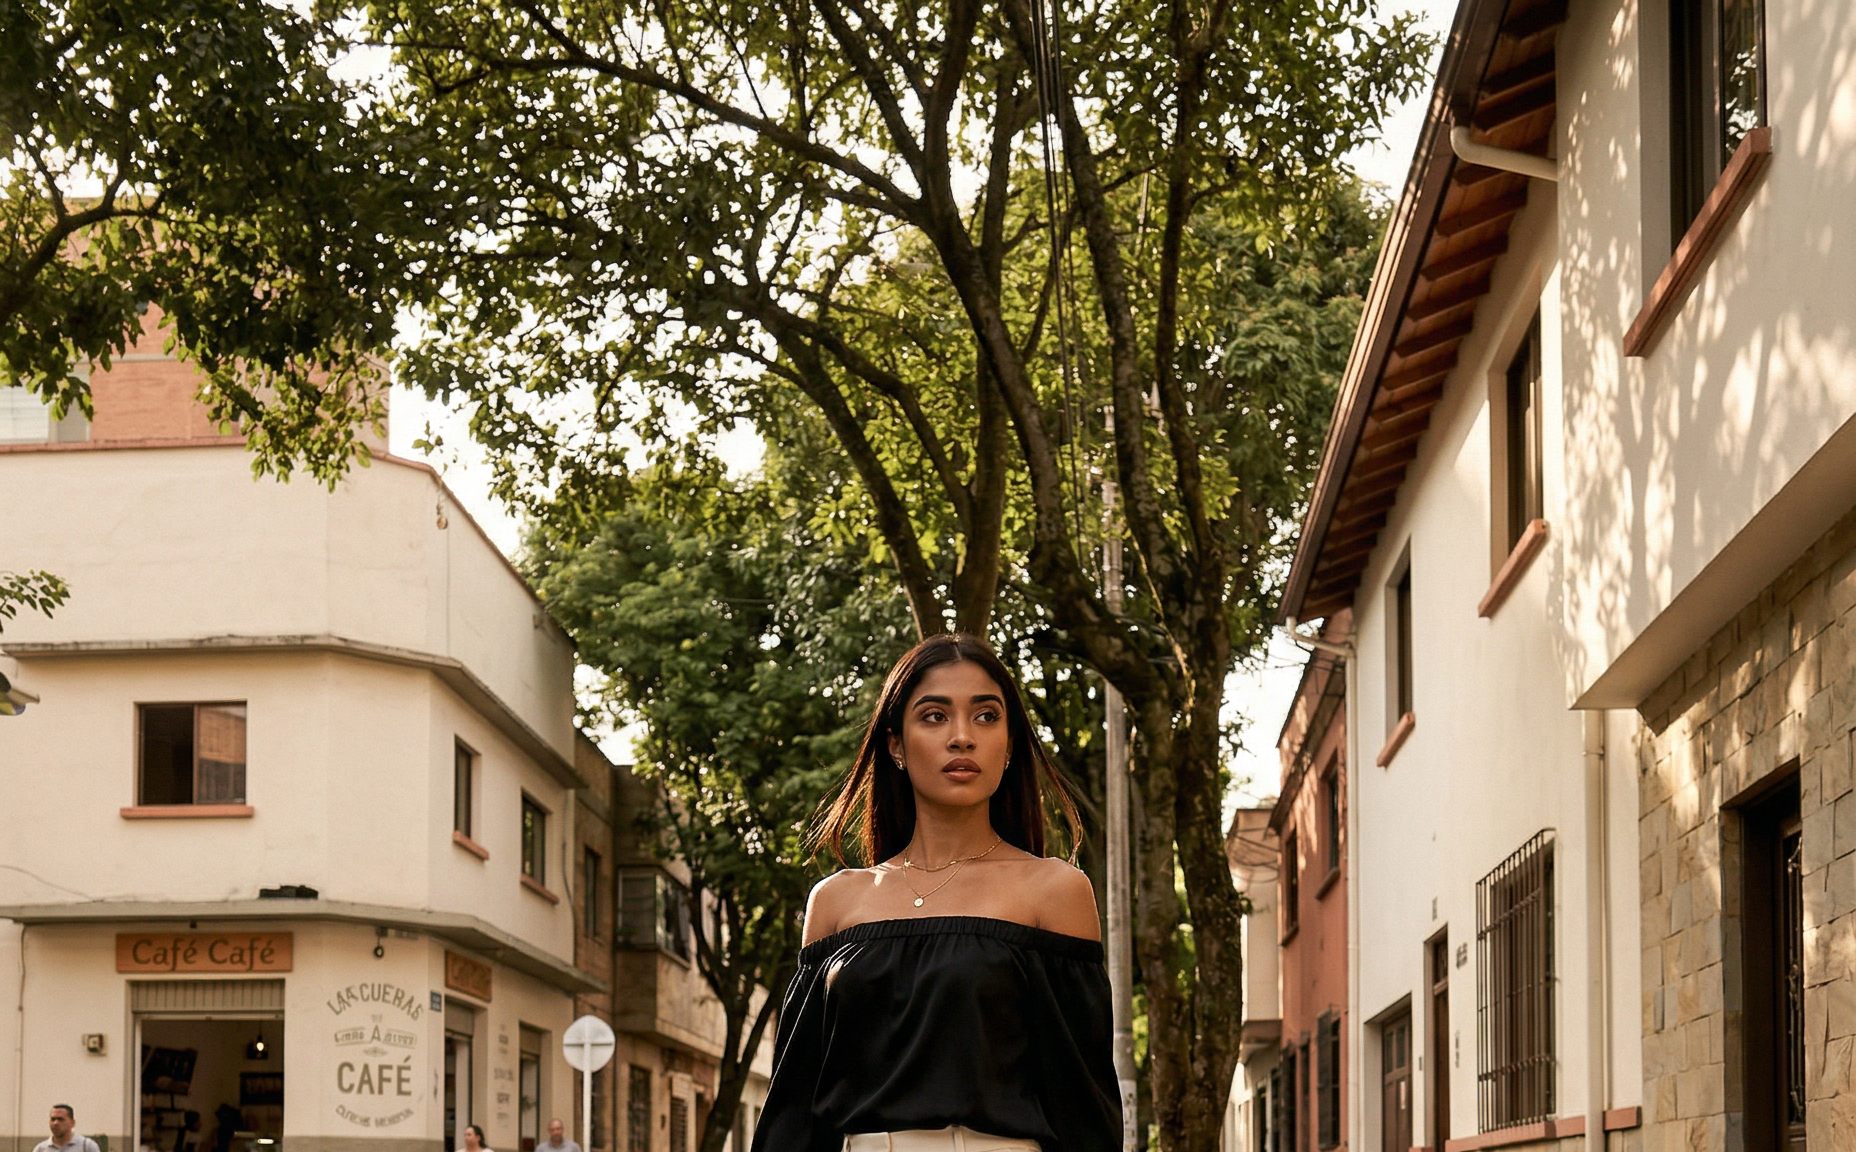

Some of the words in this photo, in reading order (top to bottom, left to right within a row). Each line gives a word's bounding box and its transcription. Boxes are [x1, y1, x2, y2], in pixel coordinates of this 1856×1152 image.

[132, 937, 198, 971] Café
[208, 937, 275, 971] Café
[337, 1054, 412, 1096] CAFÉ
